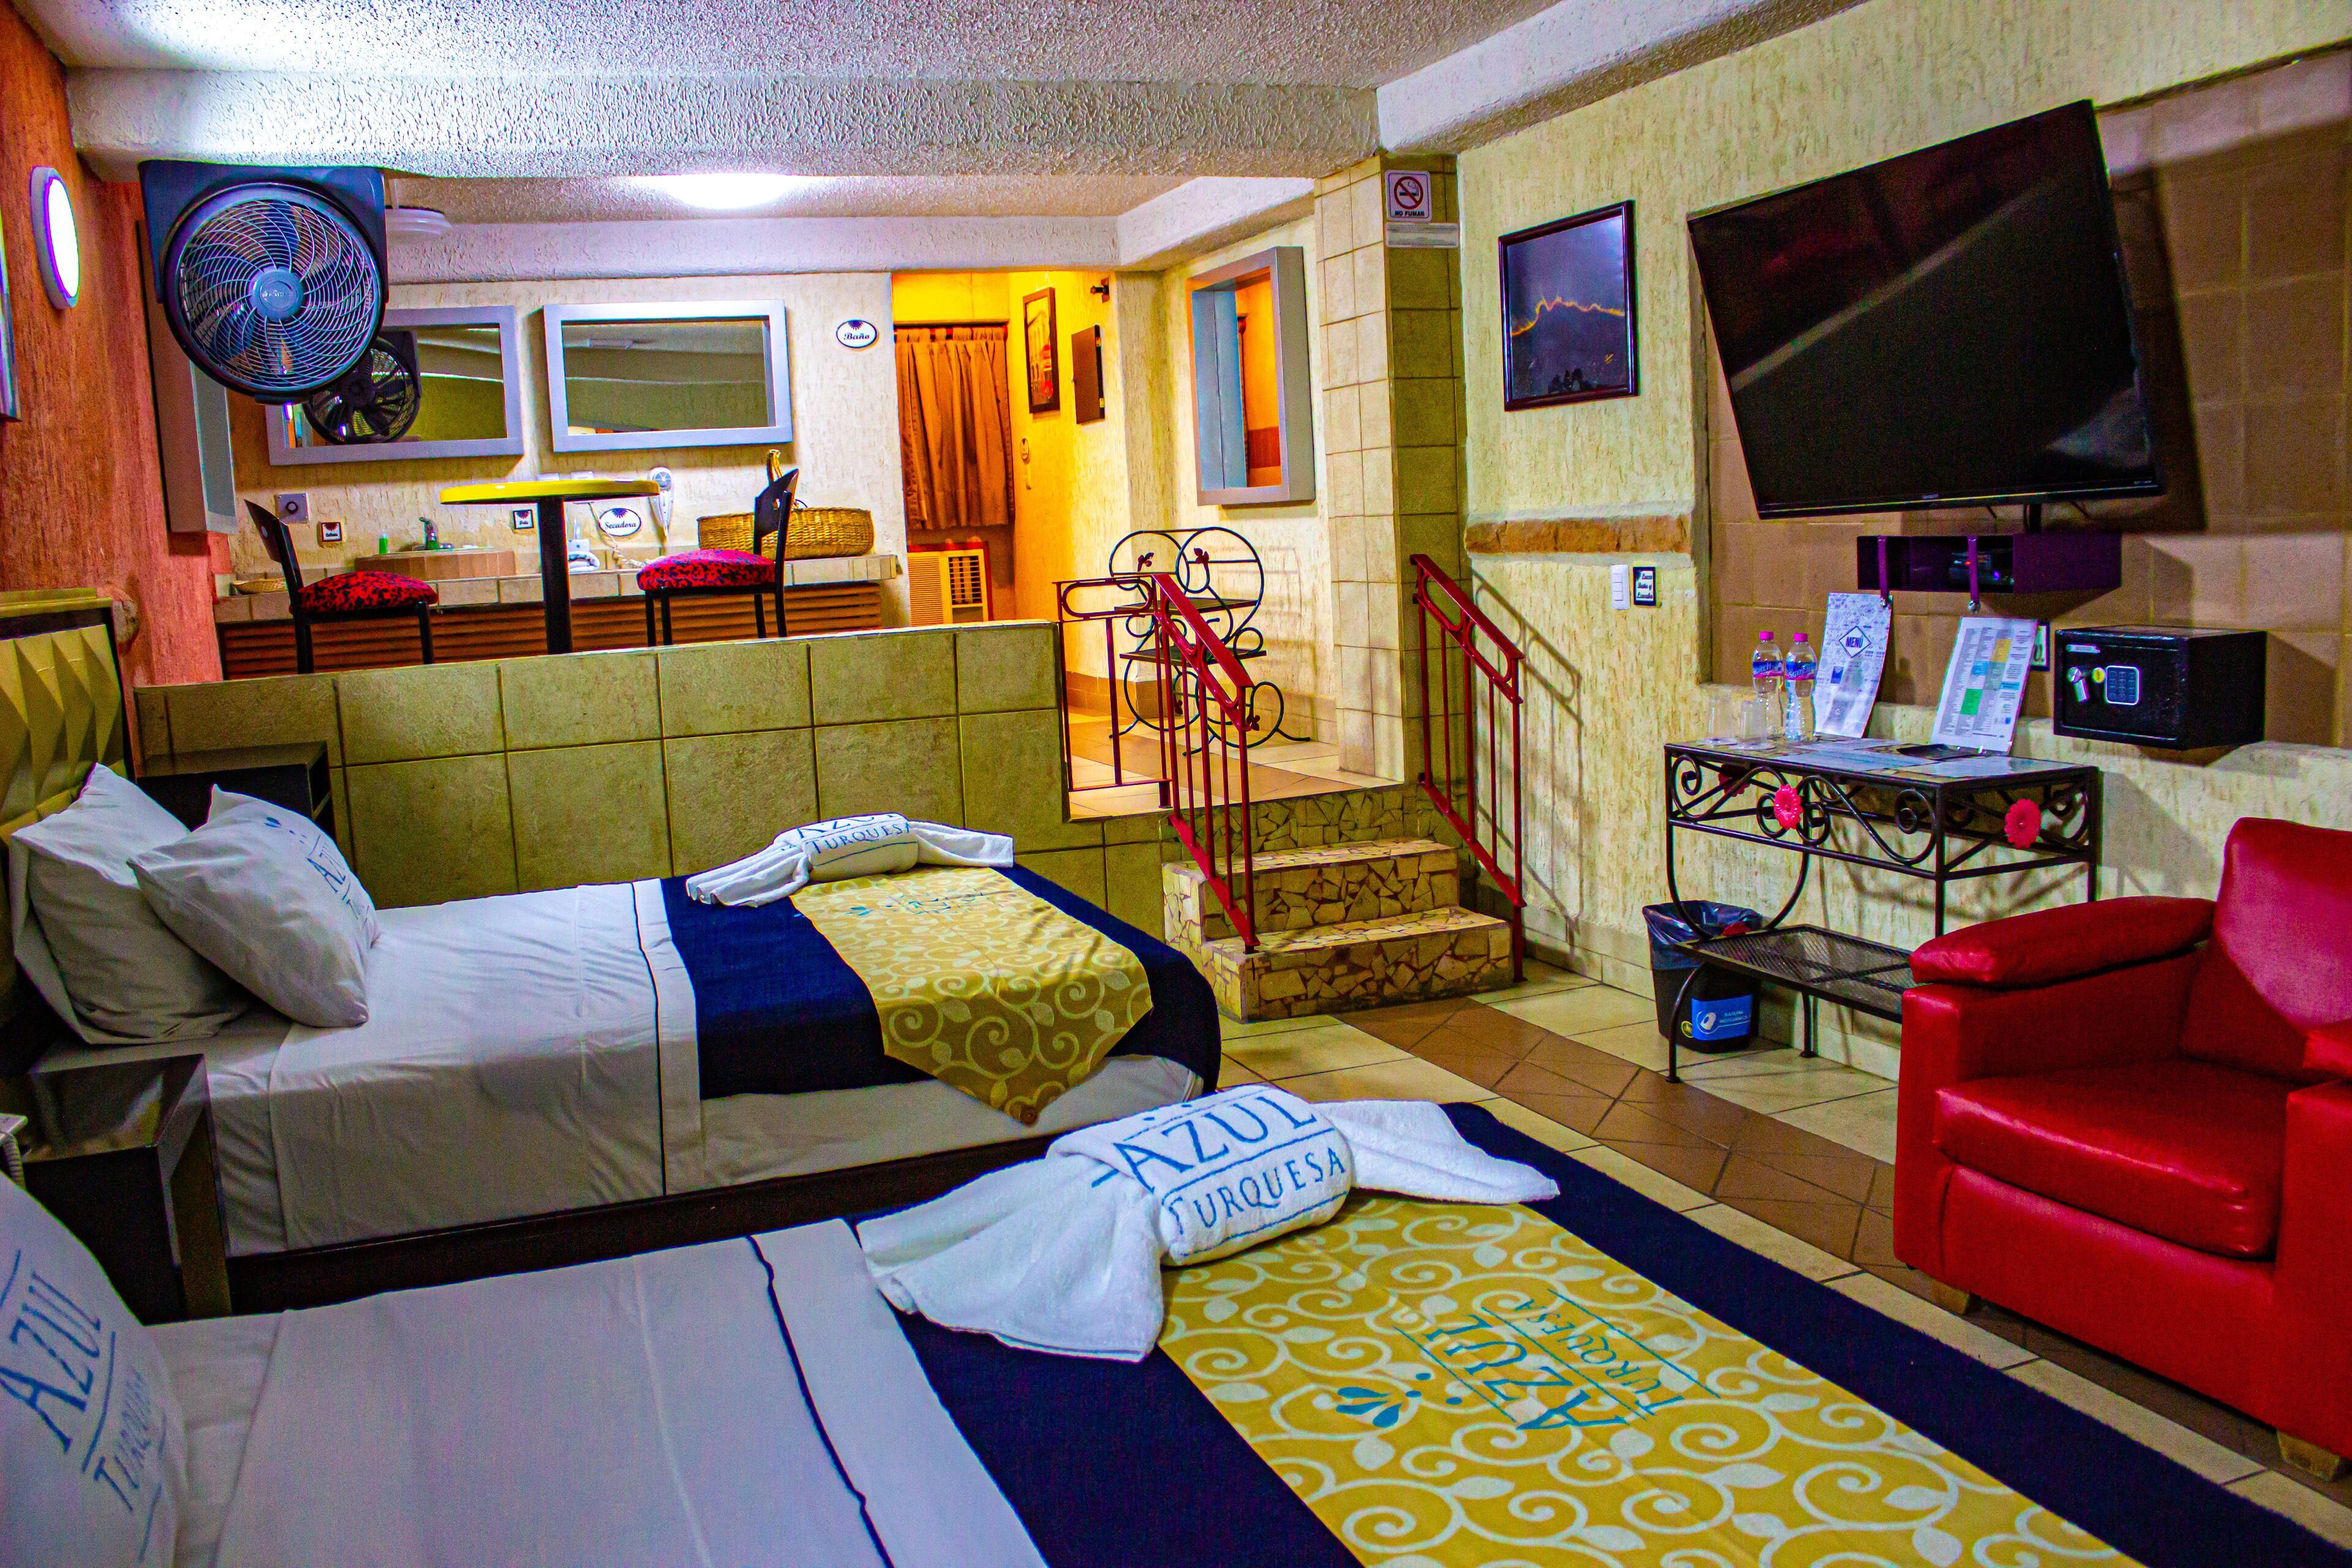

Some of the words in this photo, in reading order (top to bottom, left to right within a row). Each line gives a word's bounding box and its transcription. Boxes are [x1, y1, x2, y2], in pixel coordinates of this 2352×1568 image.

[605, 521, 636, 529] Secadora
[1845, 635, 1863, 648] MENÚ
[810, 823, 912, 854] TURQUESA
[1112, 1096, 1317, 1194] AZUL
[1166, 1147, 1346, 1235] TURQUESA
[0, 1270, 102, 1454] AZUL
[1422, 1313, 1631, 1431] AZUL
[1514, 1298, 1686, 1416] TURQUESA
